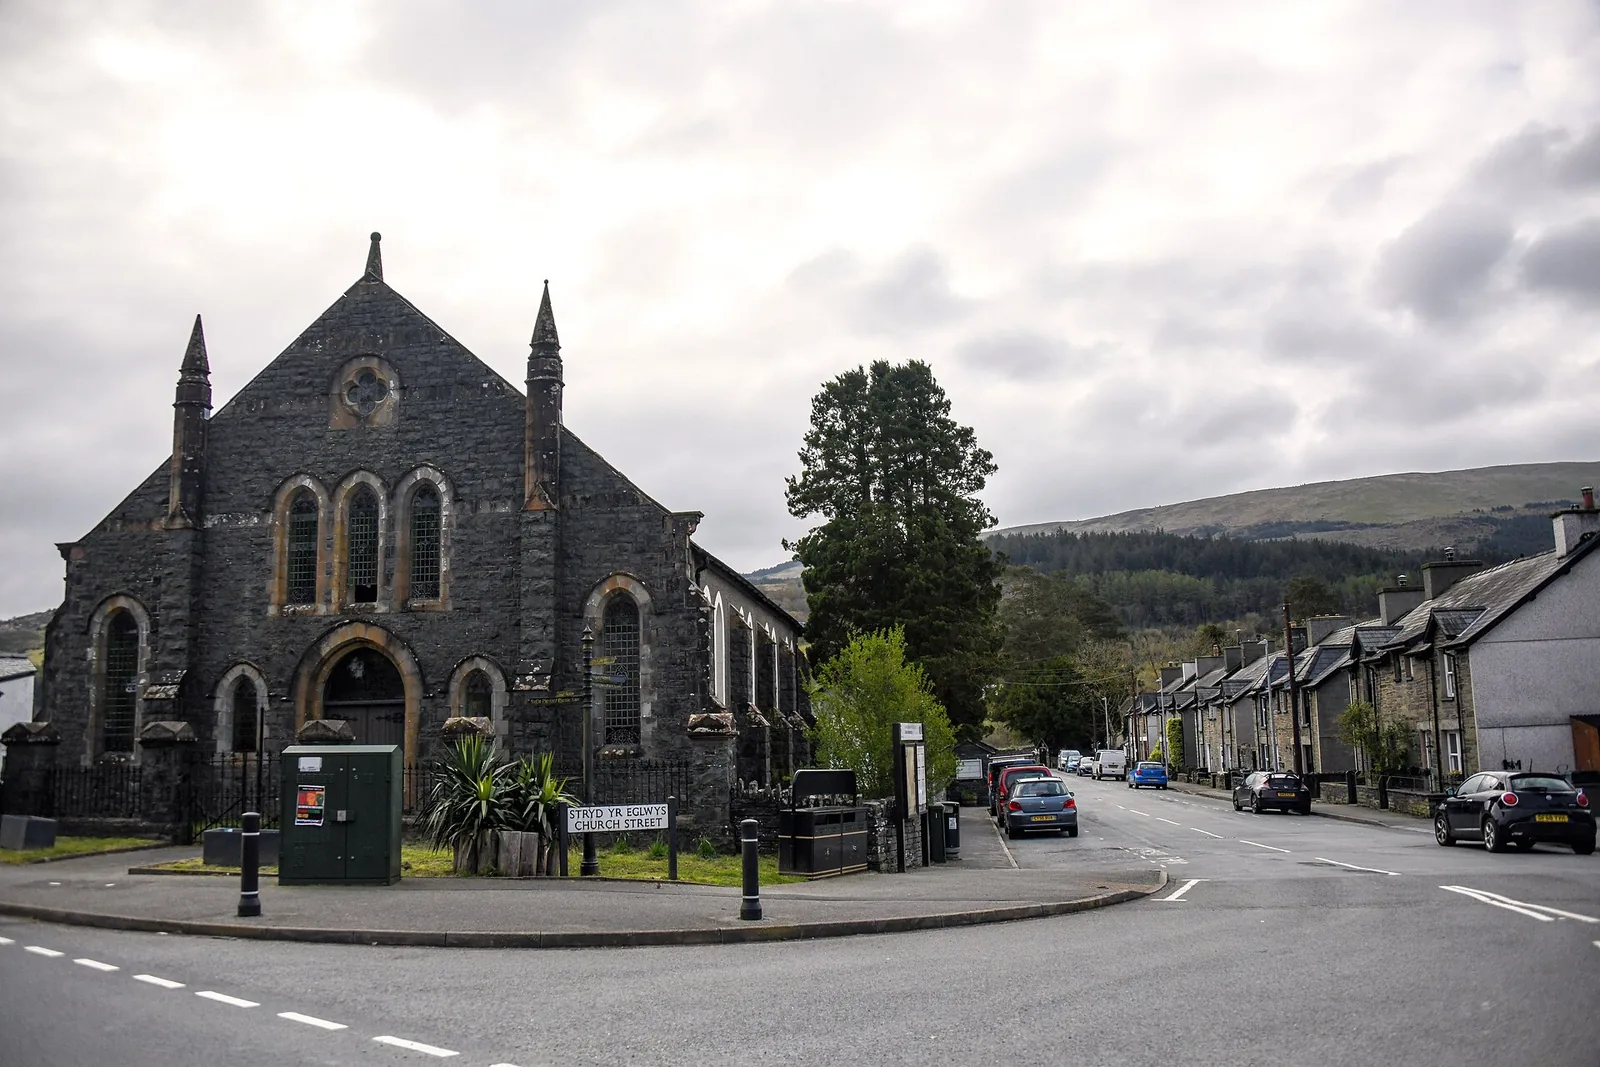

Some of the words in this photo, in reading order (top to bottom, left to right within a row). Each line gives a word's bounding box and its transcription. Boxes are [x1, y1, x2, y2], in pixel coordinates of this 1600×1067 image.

[569, 809, 604, 819] STRYD
[608, 808, 623, 818] YR
[626, 806, 667, 817] EGLWYS
[574, 819, 620, 831] CHURCH
[624, 817, 663, 829] STREET
